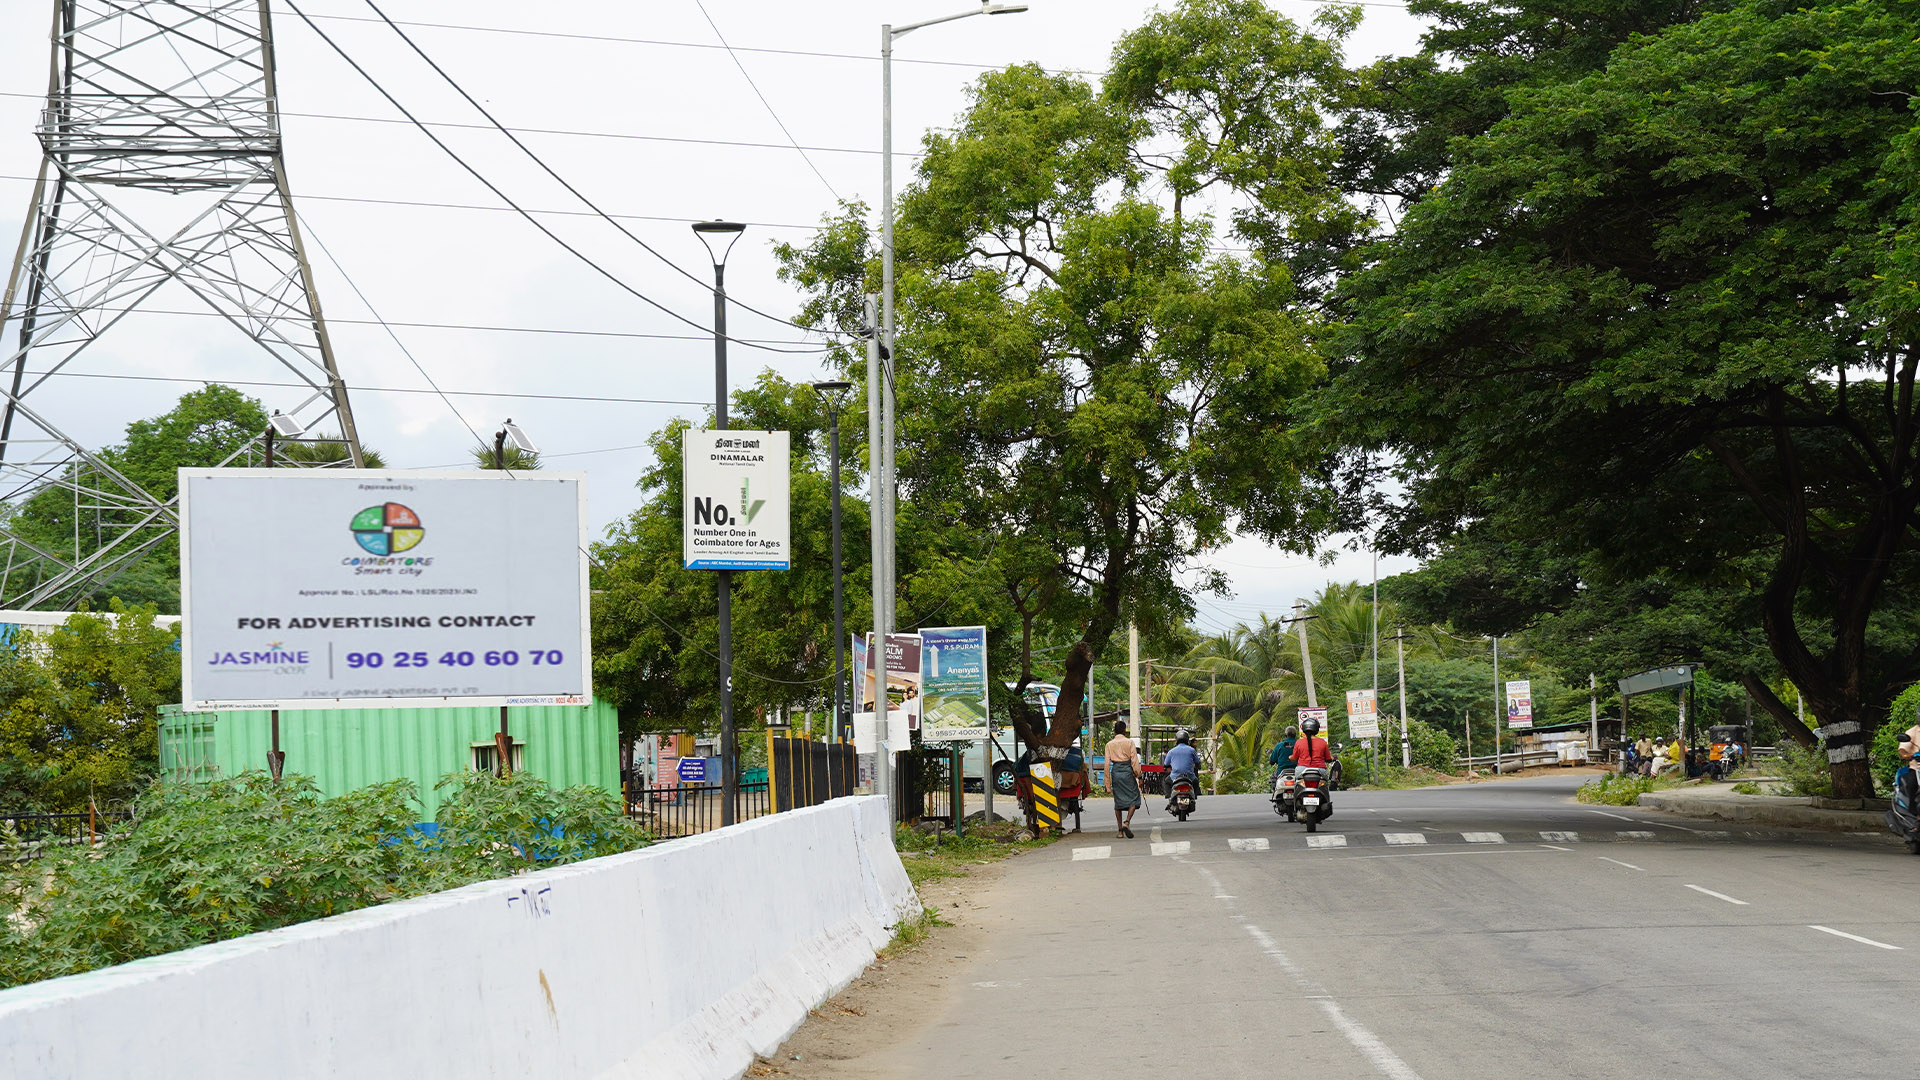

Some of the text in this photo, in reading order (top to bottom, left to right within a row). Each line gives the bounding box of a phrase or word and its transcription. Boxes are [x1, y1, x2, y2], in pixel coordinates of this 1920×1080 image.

[710, 454, 764, 462] DINAMALAR
[694, 496, 736, 526] No.
[694, 528, 756, 537] Number One in
[694, 538, 780, 549] Coimbatore for Ages
[342, 557, 434, 566] COIMBATORE
[354, 566, 423, 576] Smart city
[238, 615, 536, 630] FOR ADVERTISING CONTACT
[885, 647, 903, 655] ALM
[208, 651, 310, 665] JASMINE
[346, 650, 563, 668] 90 25 40 60 70
